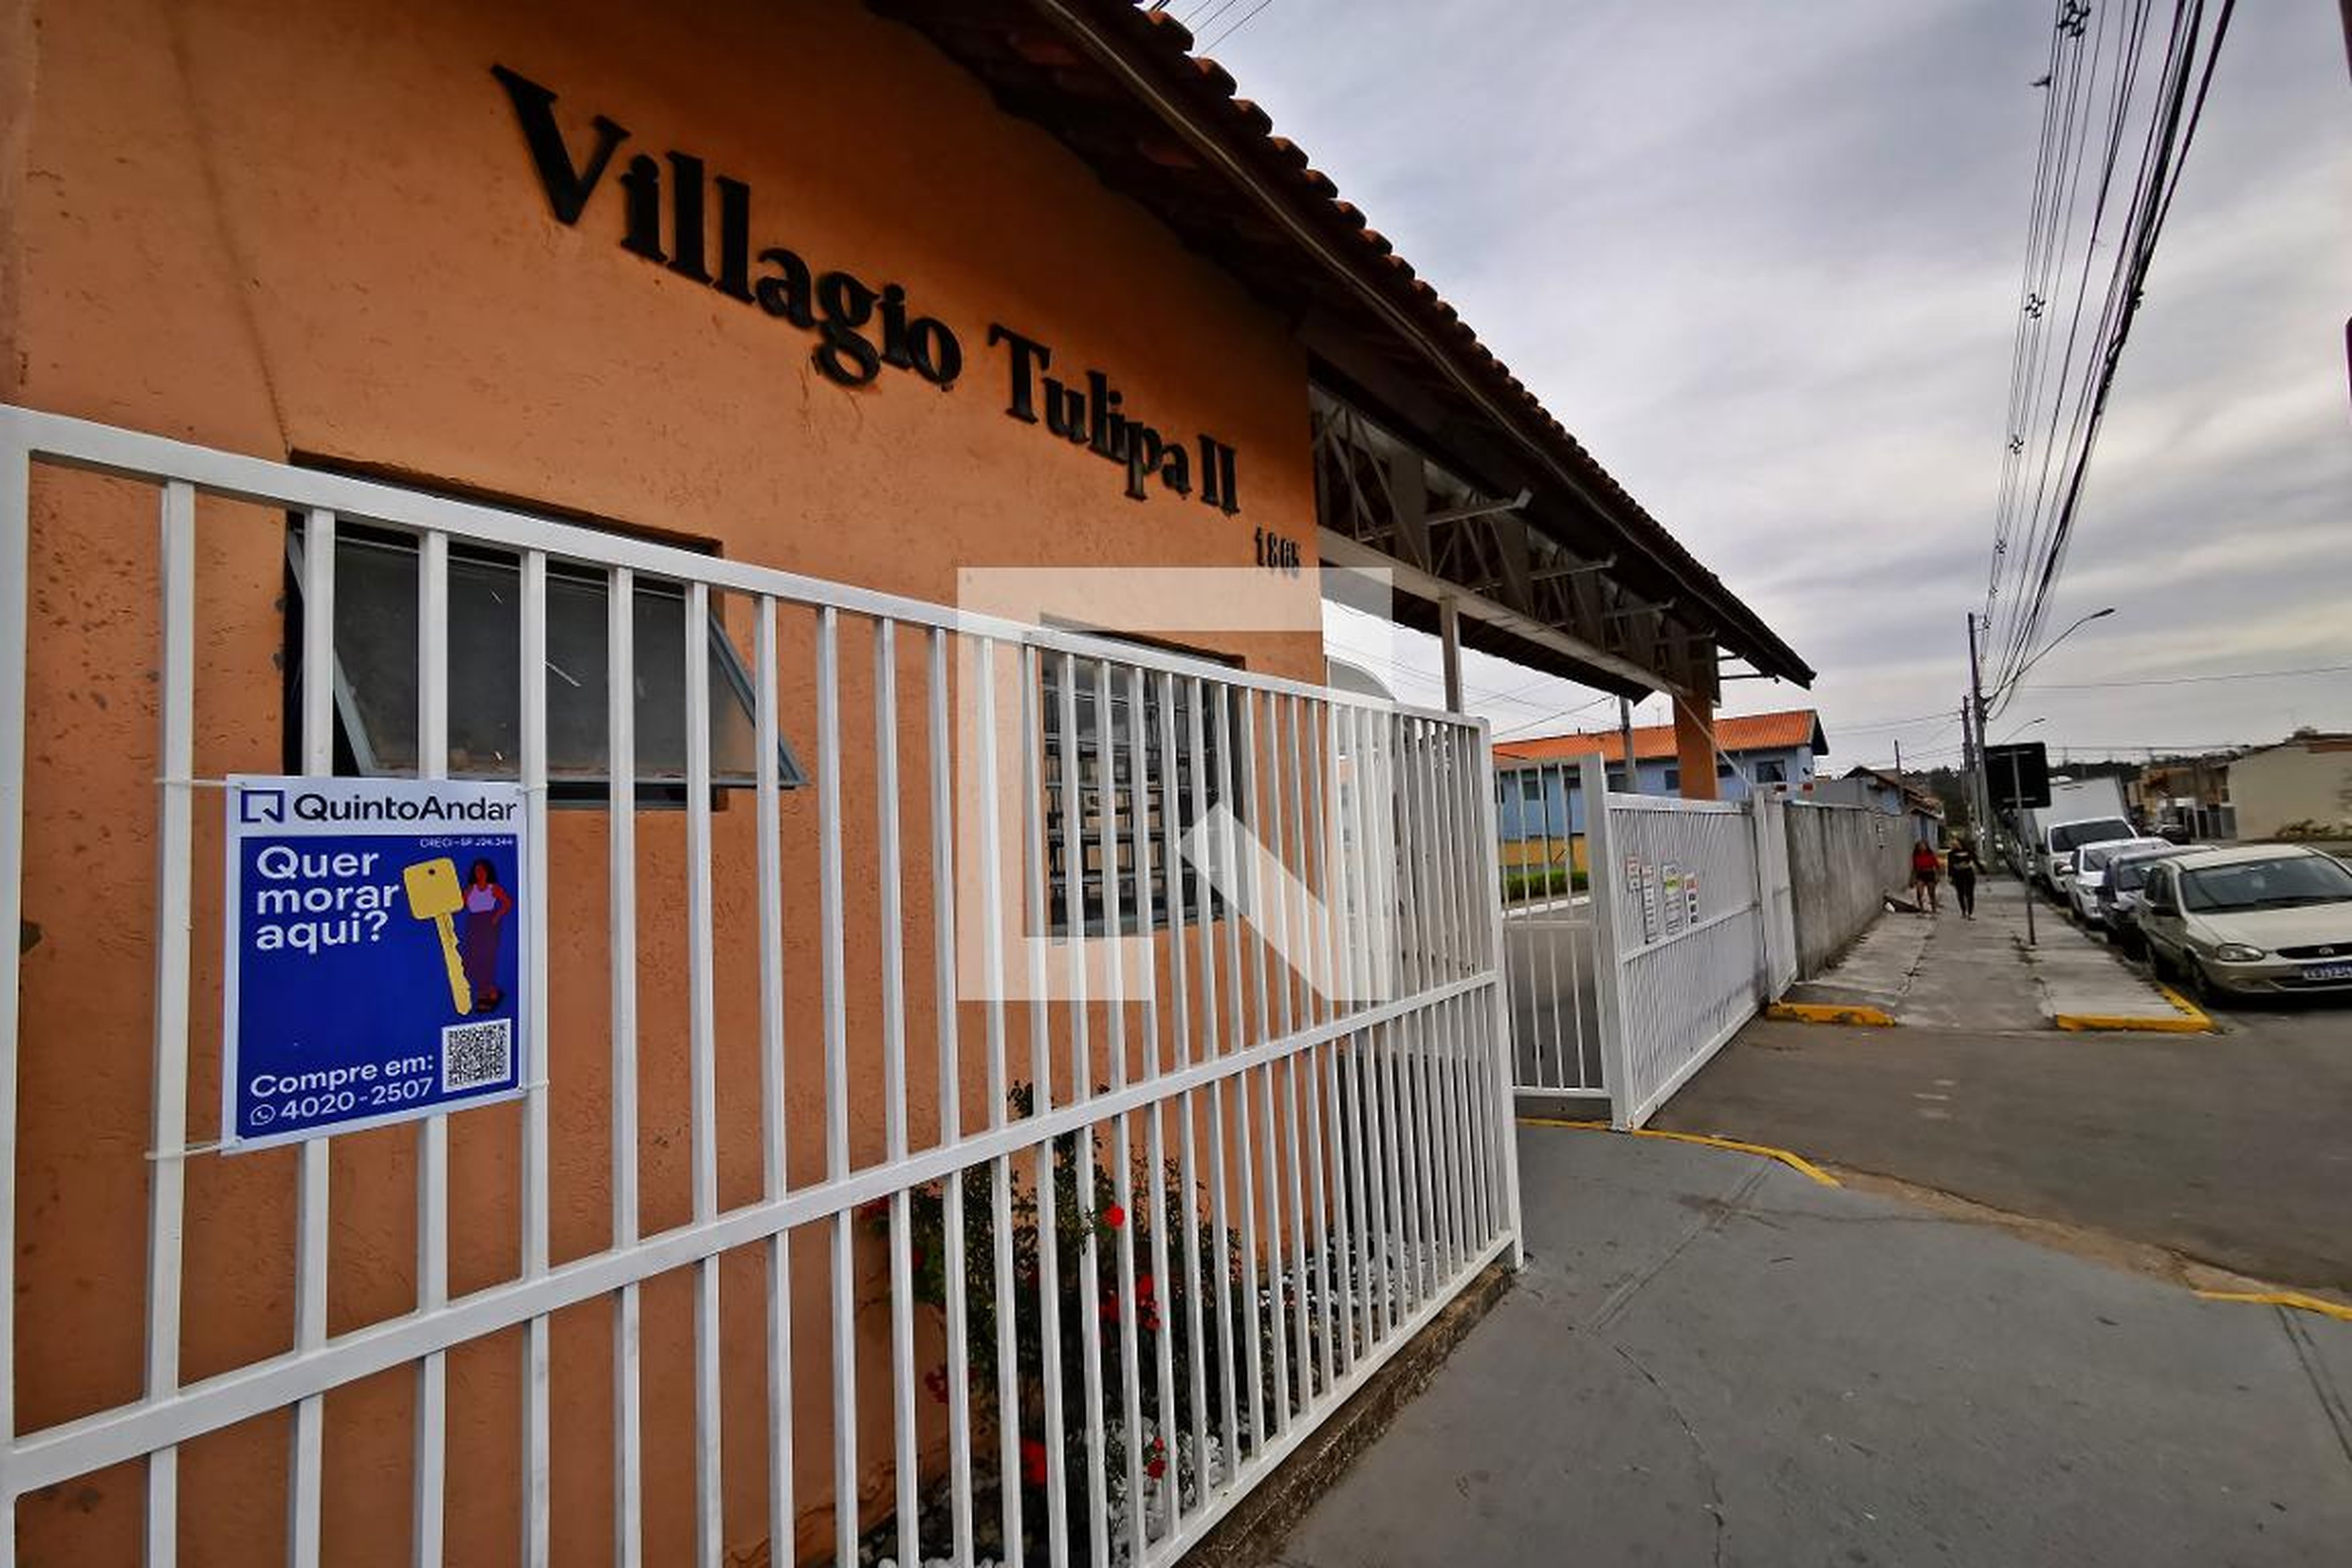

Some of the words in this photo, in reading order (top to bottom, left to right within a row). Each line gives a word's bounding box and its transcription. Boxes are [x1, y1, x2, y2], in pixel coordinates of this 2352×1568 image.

[492, 65, 962, 389] Villagio
[988, 323, 1192, 502] Tulipa
[294, 794, 518, 822] QuintoAndar
[257, 846, 379, 880] Quer
[257, 883, 399, 914] morar
[256, 910, 388, 954] aqui?
[251, 1064, 377, 1097] Compre
[385, 1055, 433, 1076] em:
